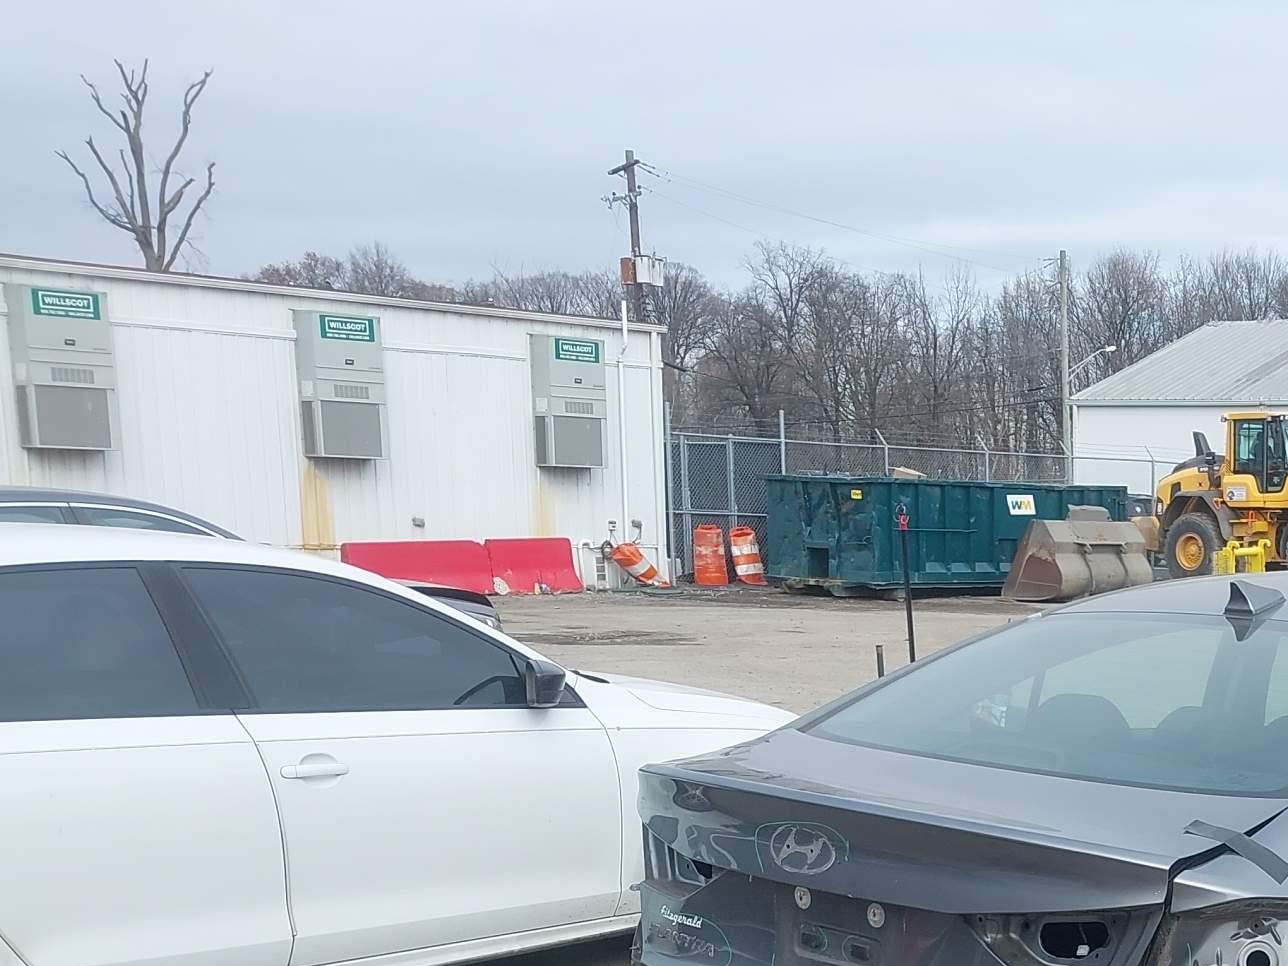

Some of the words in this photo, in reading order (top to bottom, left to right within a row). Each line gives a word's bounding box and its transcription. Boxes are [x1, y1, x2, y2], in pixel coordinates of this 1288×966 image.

[43, 296, 88, 307] WILLSCOT
[329, 321, 366, 331] WILLSCOT
[562, 344, 593, 353] WILLSCOT
[1011, 500, 1032, 510] WM
